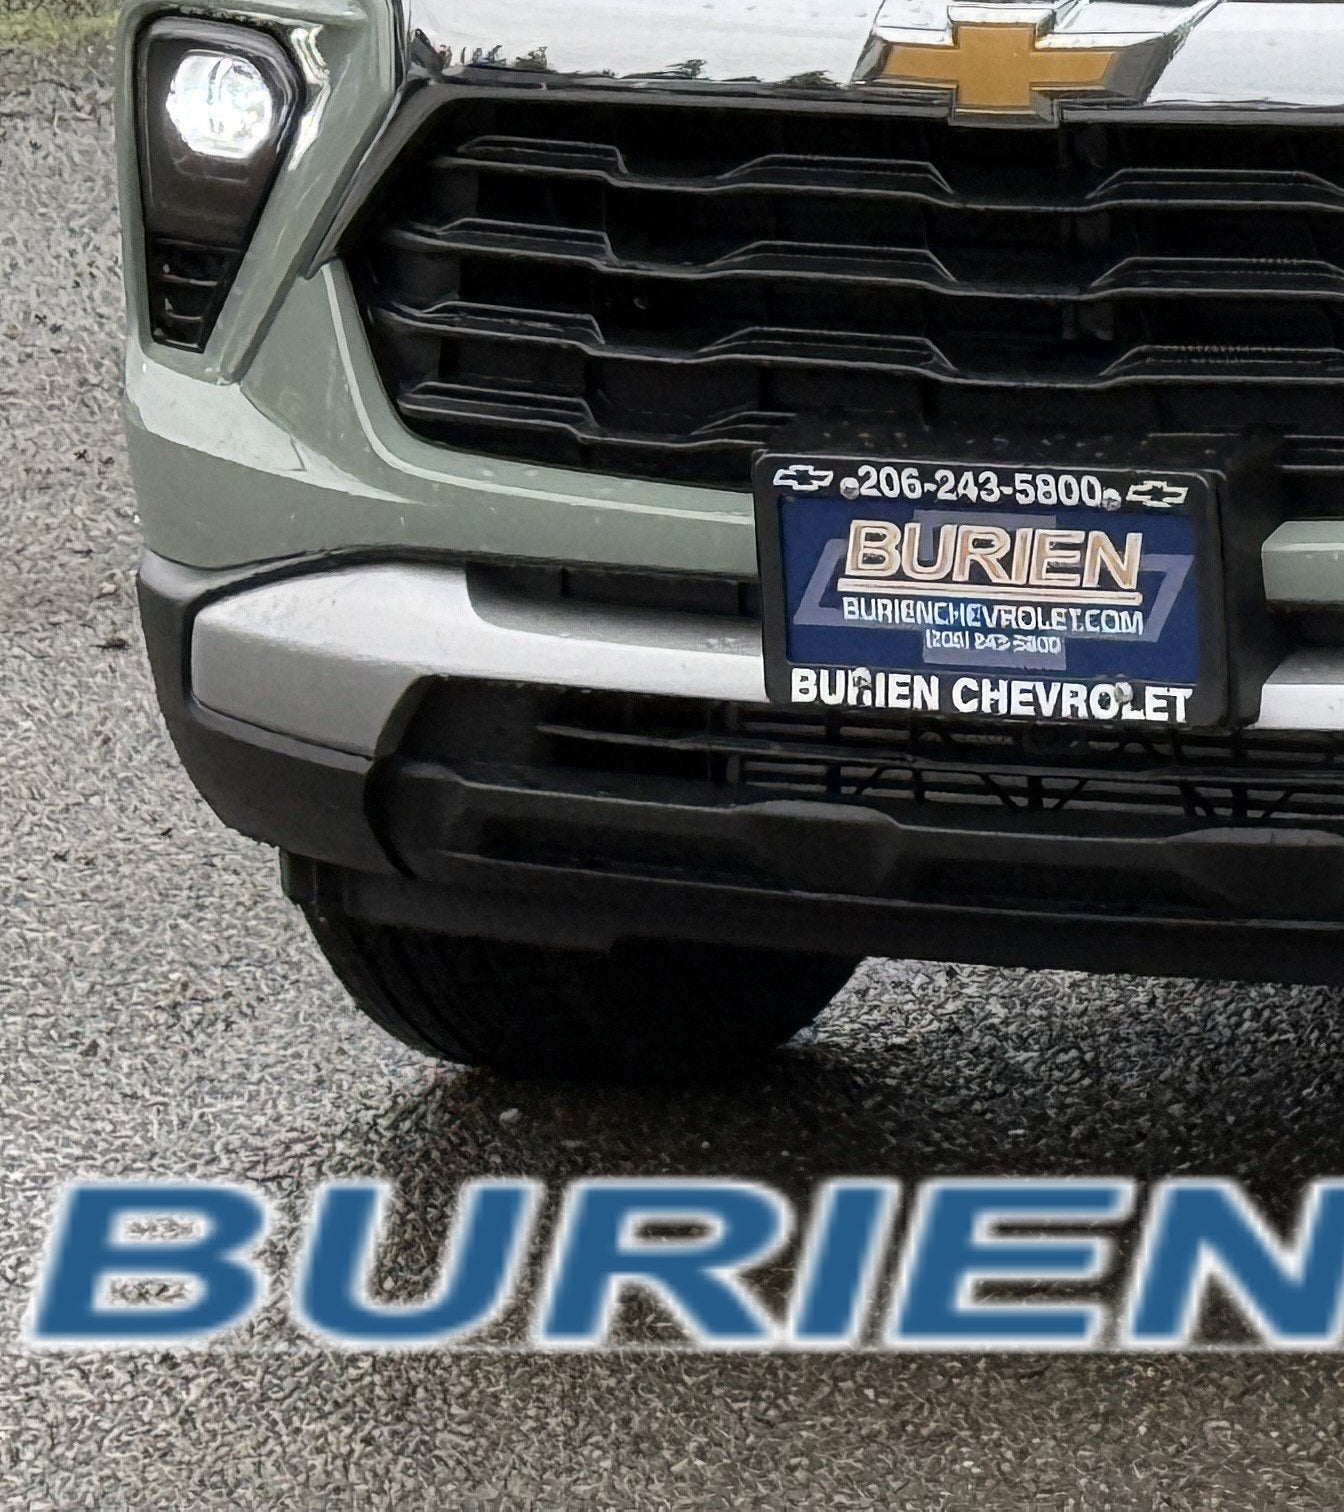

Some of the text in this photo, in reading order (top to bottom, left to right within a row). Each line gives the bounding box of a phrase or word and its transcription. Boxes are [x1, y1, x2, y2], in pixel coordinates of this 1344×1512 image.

[857, 466, 1101, 508] 206-243-5800
[844, 519, 1143, 590] BURIEN
[842, 596, 1143, 635] BURIENCHEVROLET.COM
[791, 667, 1193, 724] BURIEN CHEVROLET
